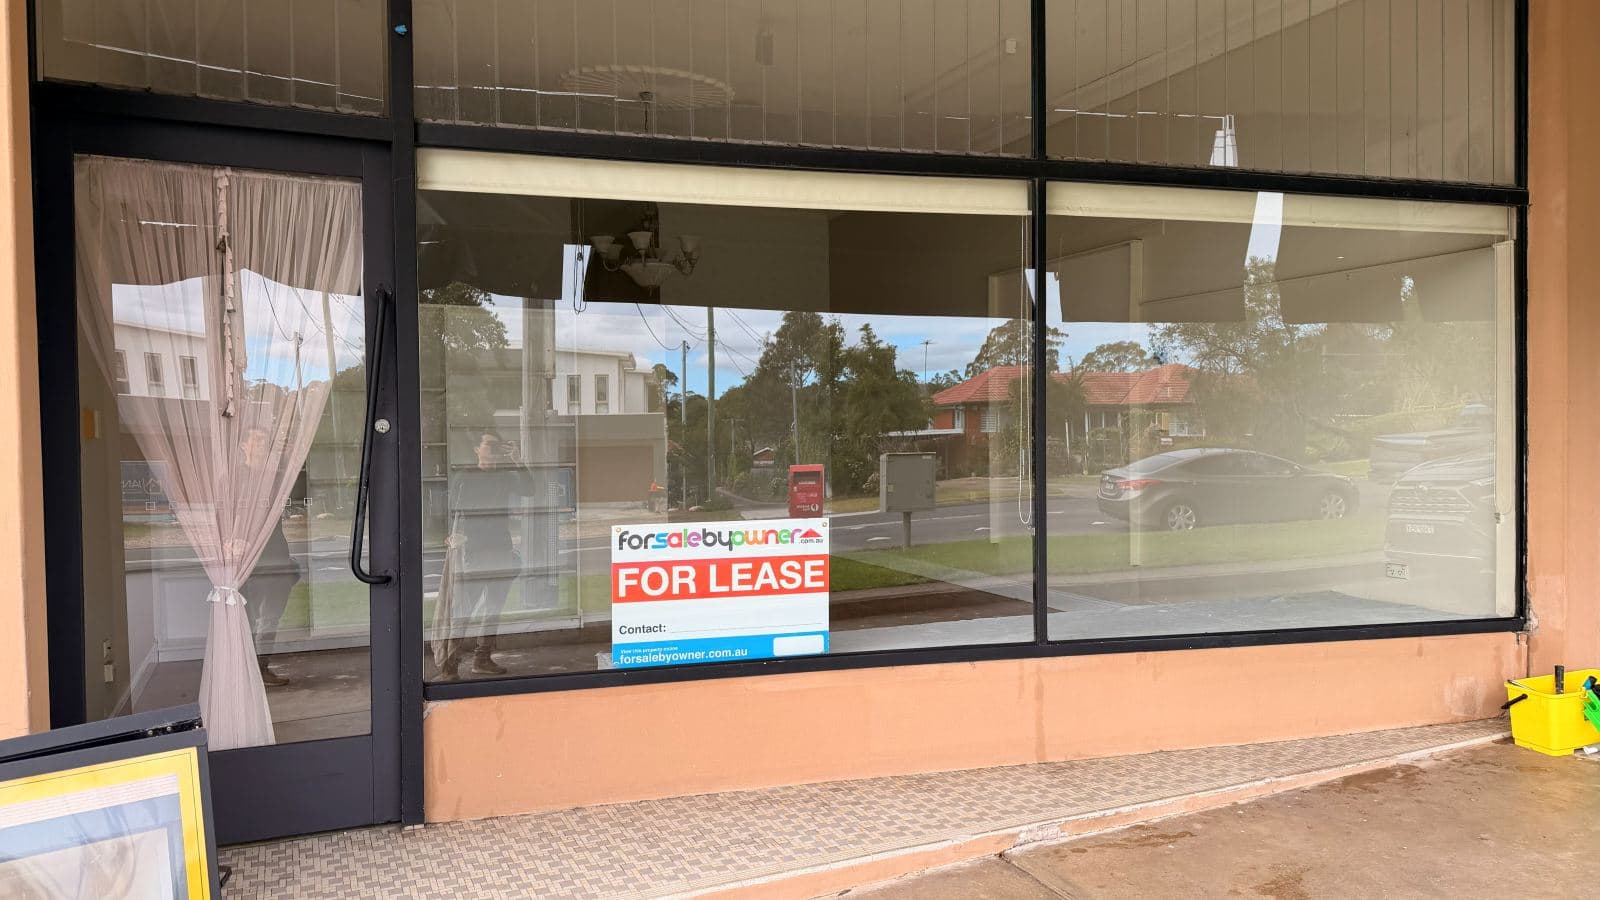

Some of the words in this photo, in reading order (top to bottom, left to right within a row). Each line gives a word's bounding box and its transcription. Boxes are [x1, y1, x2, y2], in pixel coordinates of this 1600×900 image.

[618, 528, 802, 551] forsalebyowner
[618, 565, 697, 598] FOR
[709, 560, 825, 593] LEASE
[619, 623, 667, 635] Contact:
[619, 648, 748, 664] forsalebyowner.com.au
